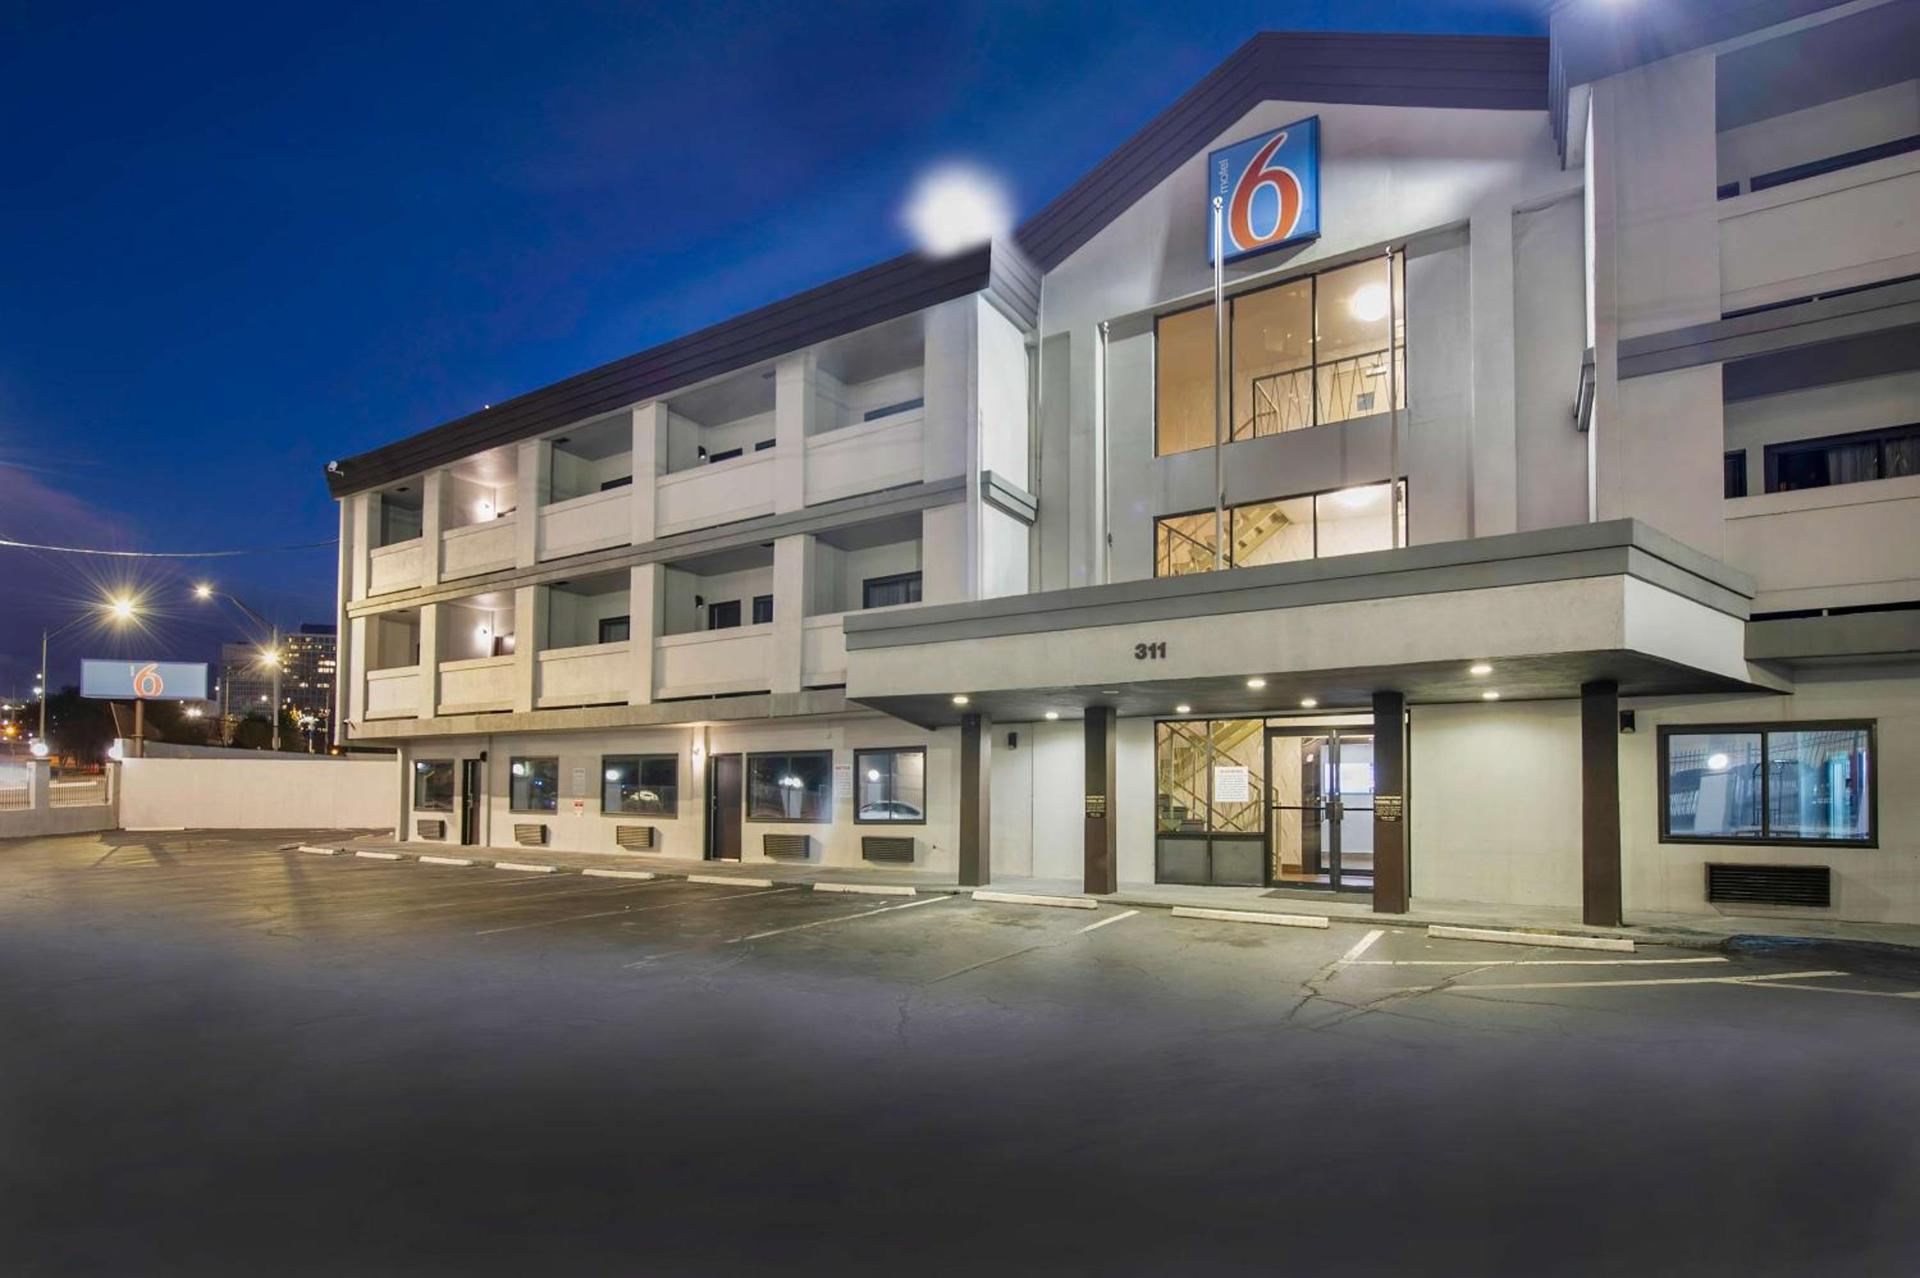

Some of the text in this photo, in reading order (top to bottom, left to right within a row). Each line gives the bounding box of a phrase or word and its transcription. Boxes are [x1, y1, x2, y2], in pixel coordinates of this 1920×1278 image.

[1219, 158, 1229, 194] motel
[1228, 131, 1303, 252] 6
[1134, 641, 1167, 660] 311
[133, 662, 164, 698] 6
